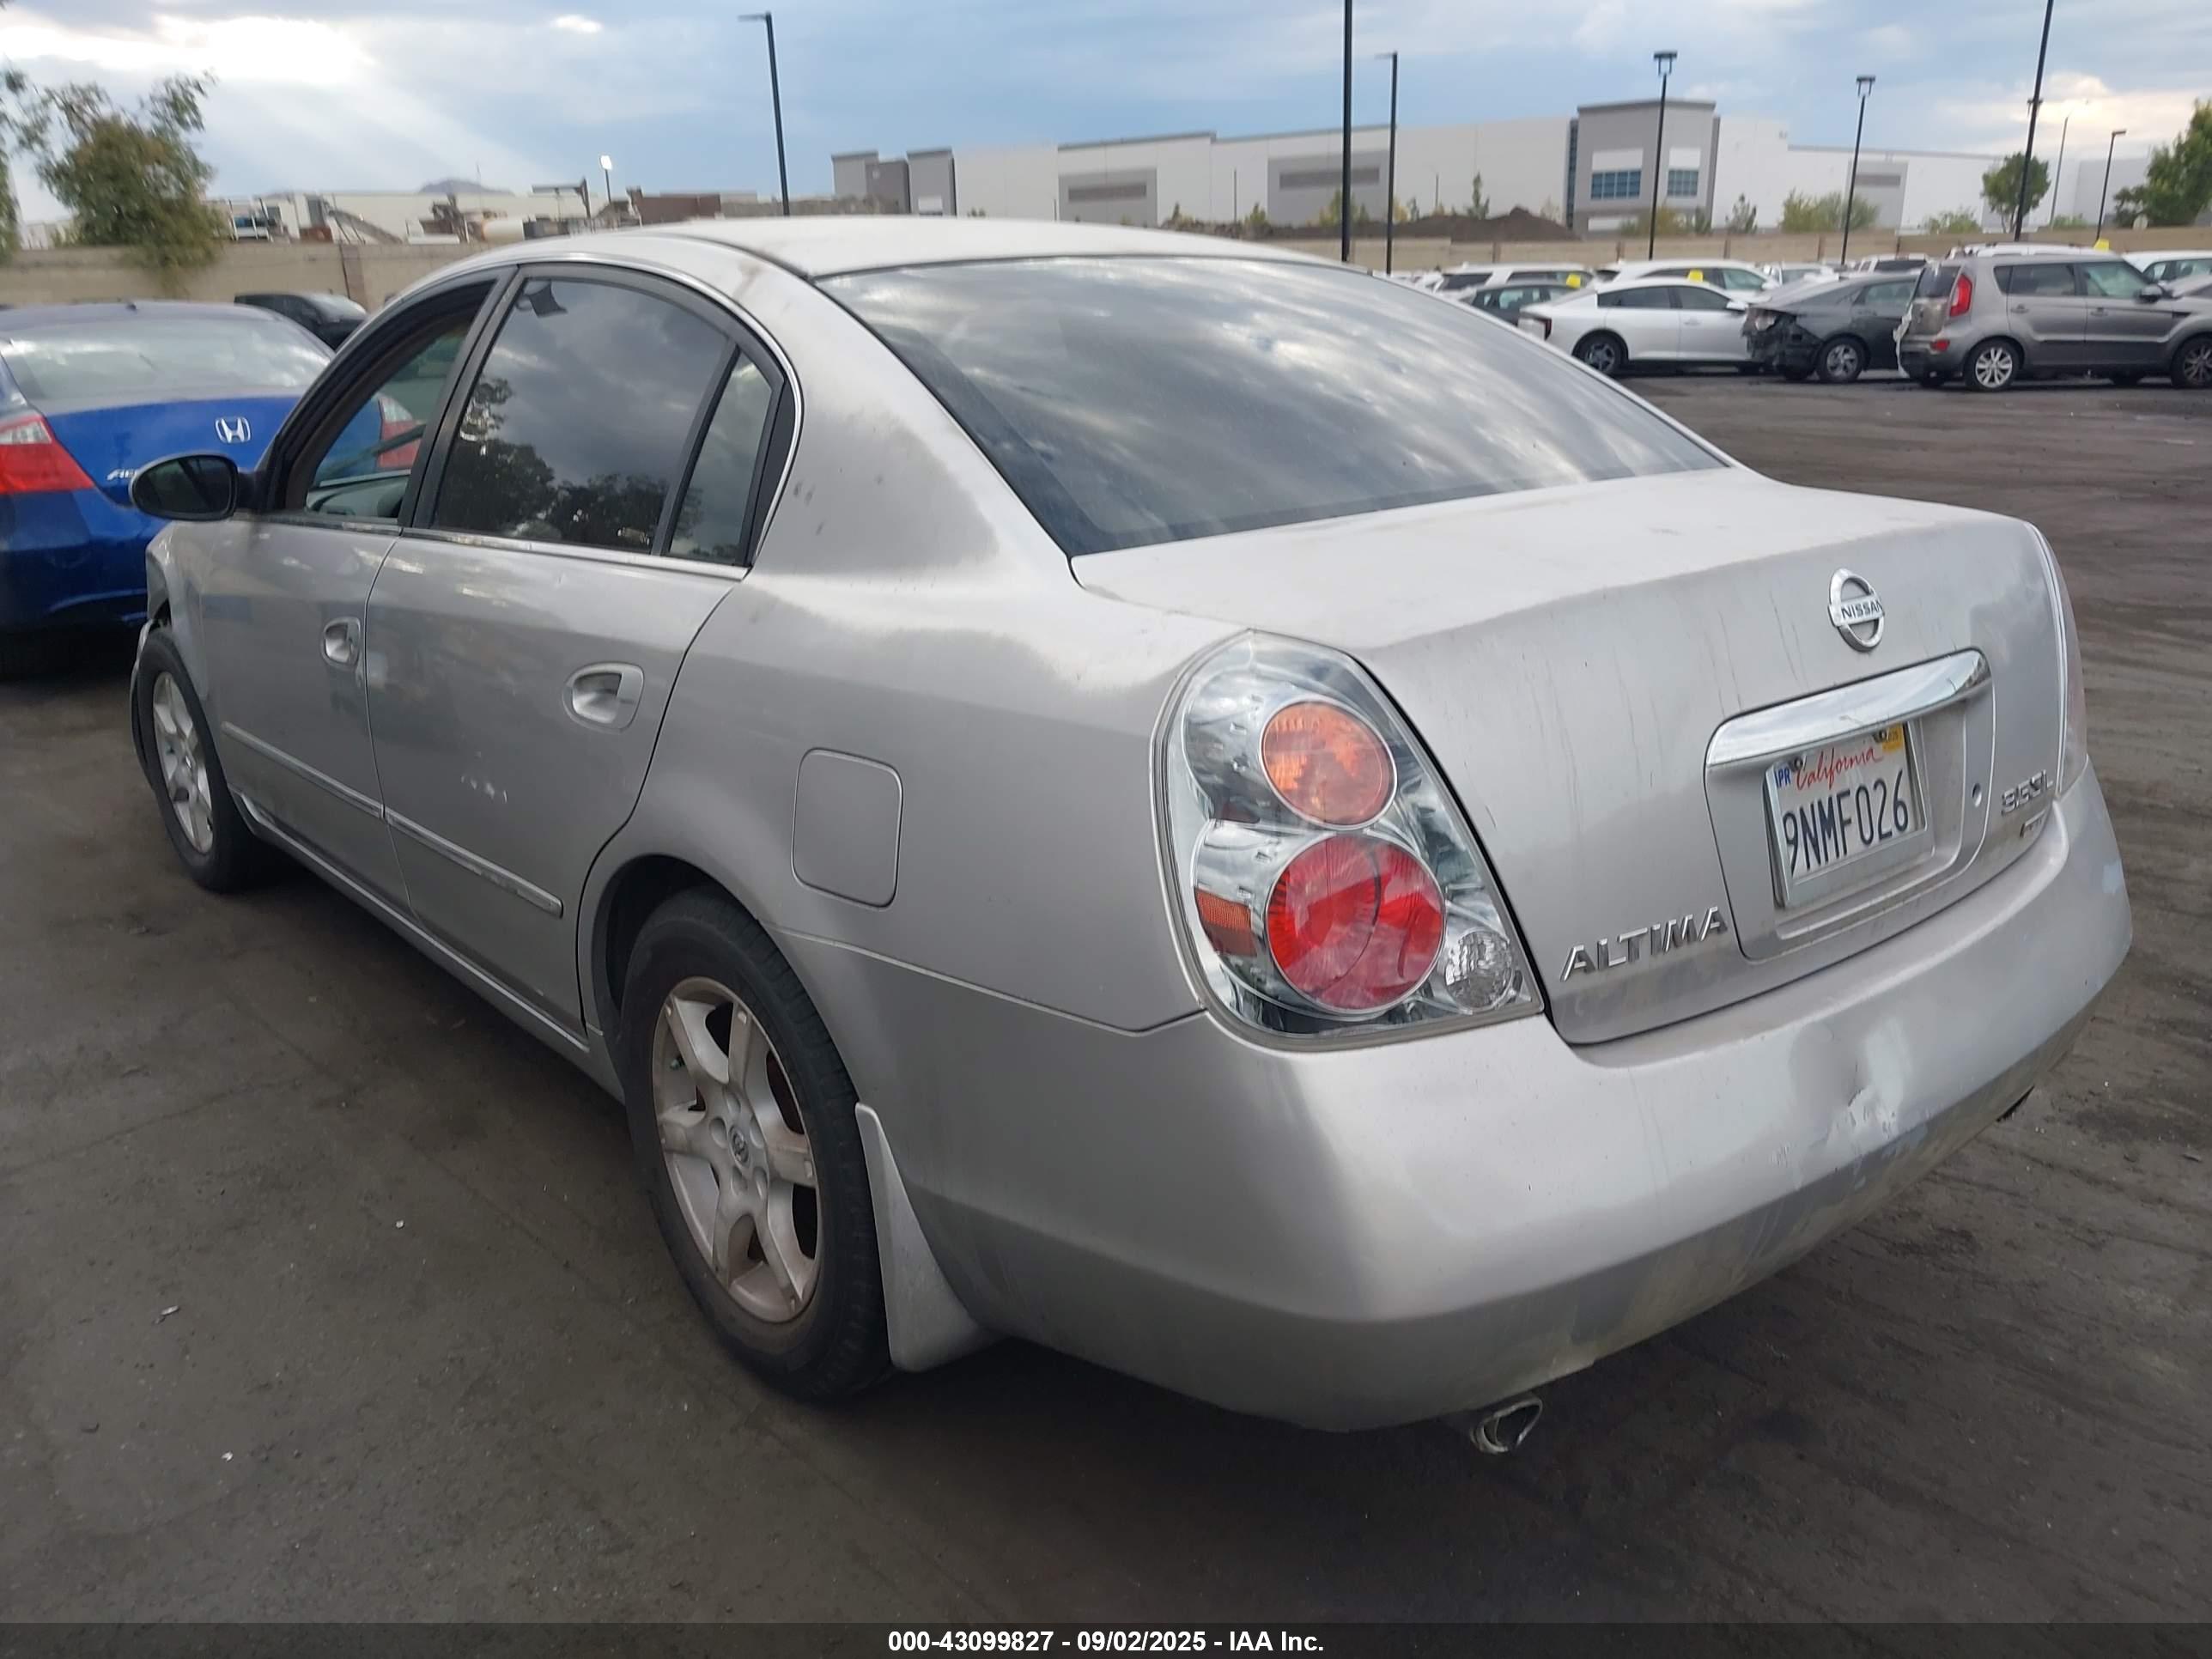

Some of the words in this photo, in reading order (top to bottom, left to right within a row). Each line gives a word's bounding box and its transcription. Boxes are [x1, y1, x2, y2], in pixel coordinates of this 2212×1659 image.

[1841, 599, 1883, 619] NISSAN
[1795, 745, 1884, 791] California
[1782, 769, 1909, 878] 9NMF026
[1559, 906, 1728, 982] ALTIMA
